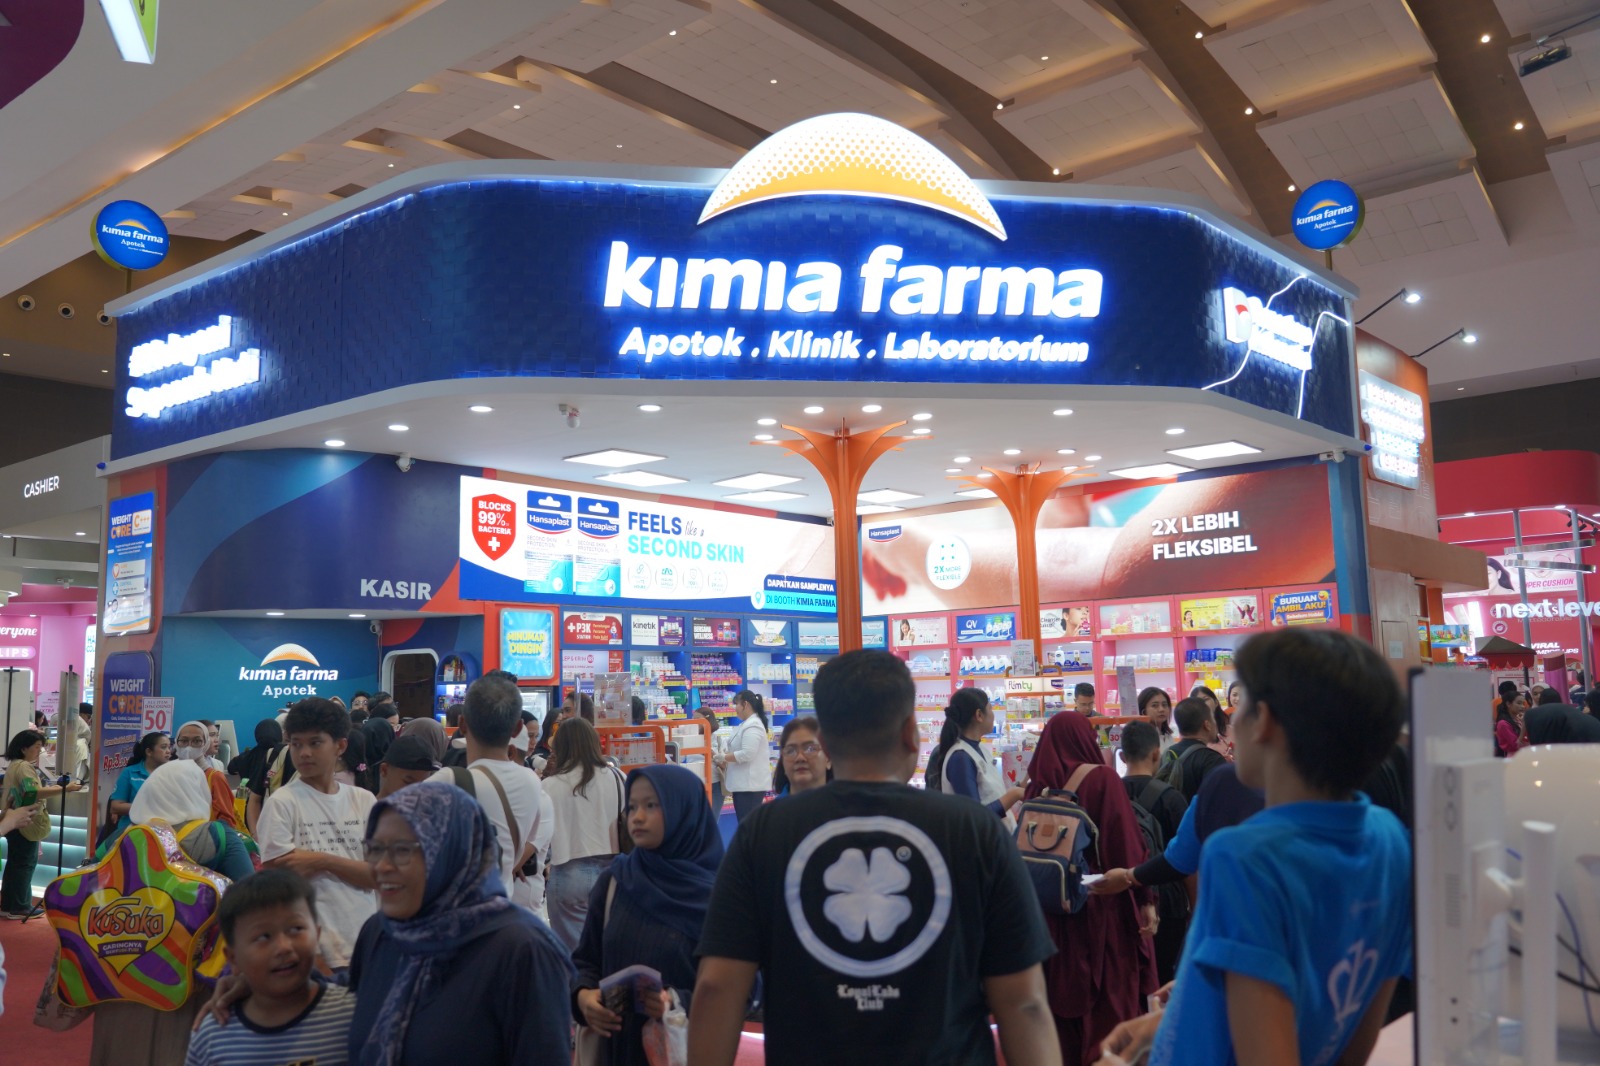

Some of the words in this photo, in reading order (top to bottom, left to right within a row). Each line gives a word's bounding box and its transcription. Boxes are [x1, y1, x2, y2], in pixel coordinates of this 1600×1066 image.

[1324, 205, 1353, 218] farma
[1314, 218, 1336, 229] Apotek
[120, 238, 146, 248] Apotek
[133, 230, 164, 244] farma
[860, 244, 1103, 318] farma
[619, 326, 742, 363] Apotek
[767, 330, 860, 360] Klinik
[884, 332, 1089, 363] Laboratorium
[24, 476, 60, 498] CASHIER
[478, 500, 512, 512] BLOCKS
[111, 514, 132, 525] WEIGHT
[478, 511, 506, 526] 99%
[529, 514, 570, 526] Hansaplast
[628, 511, 682, 536] FEELS
[685, 520, 698, 536] like
[1151, 518, 1178, 536] 2X
[1181, 510, 1239, 533] LEBIH
[478, 526, 512, 536] BACTERIA
[580, 520, 617, 532] Hansaplast
[870, 528, 900, 537] Hansaplast
[628, 534, 702, 560] SECOND
[706, 543, 744, 564] SKIN
[1152, 536, 1258, 560] FLEKSIBEL
[934, 566, 944, 574] 2X
[767, 578, 800, 590] DAPATKAN
[800, 580, 834, 592] SAMPLENYA
[1542, 578, 1574, 586] CUSHION
[360, 578, 432, 600] KASIR
[774, 595, 796, 605] BOOTH
[796, 597, 814, 606] KIMIA
[814, 598, 836, 608] FARMA
[1280, 594, 1317, 605] BURUAN
[1276, 603, 1303, 613] AMBIL
[1304, 602, 1326, 610] AKU!
[576, 622, 592, 634] P3K
[633, 622, 656, 630] kinetik
[966, 620, 978, 629] QV
[508, 632, 546, 641] MINUMAN
[510, 643, 542, 654] DINGIN
[289, 665, 339, 681] farma
[110, 679, 145, 692] WEIGHT
[262, 684, 316, 698] Apotek
[1008, 680, 1032, 691] flimty
[1110, 734, 1120, 742] 30
[103, 942, 142, 950] GARINGNYA
